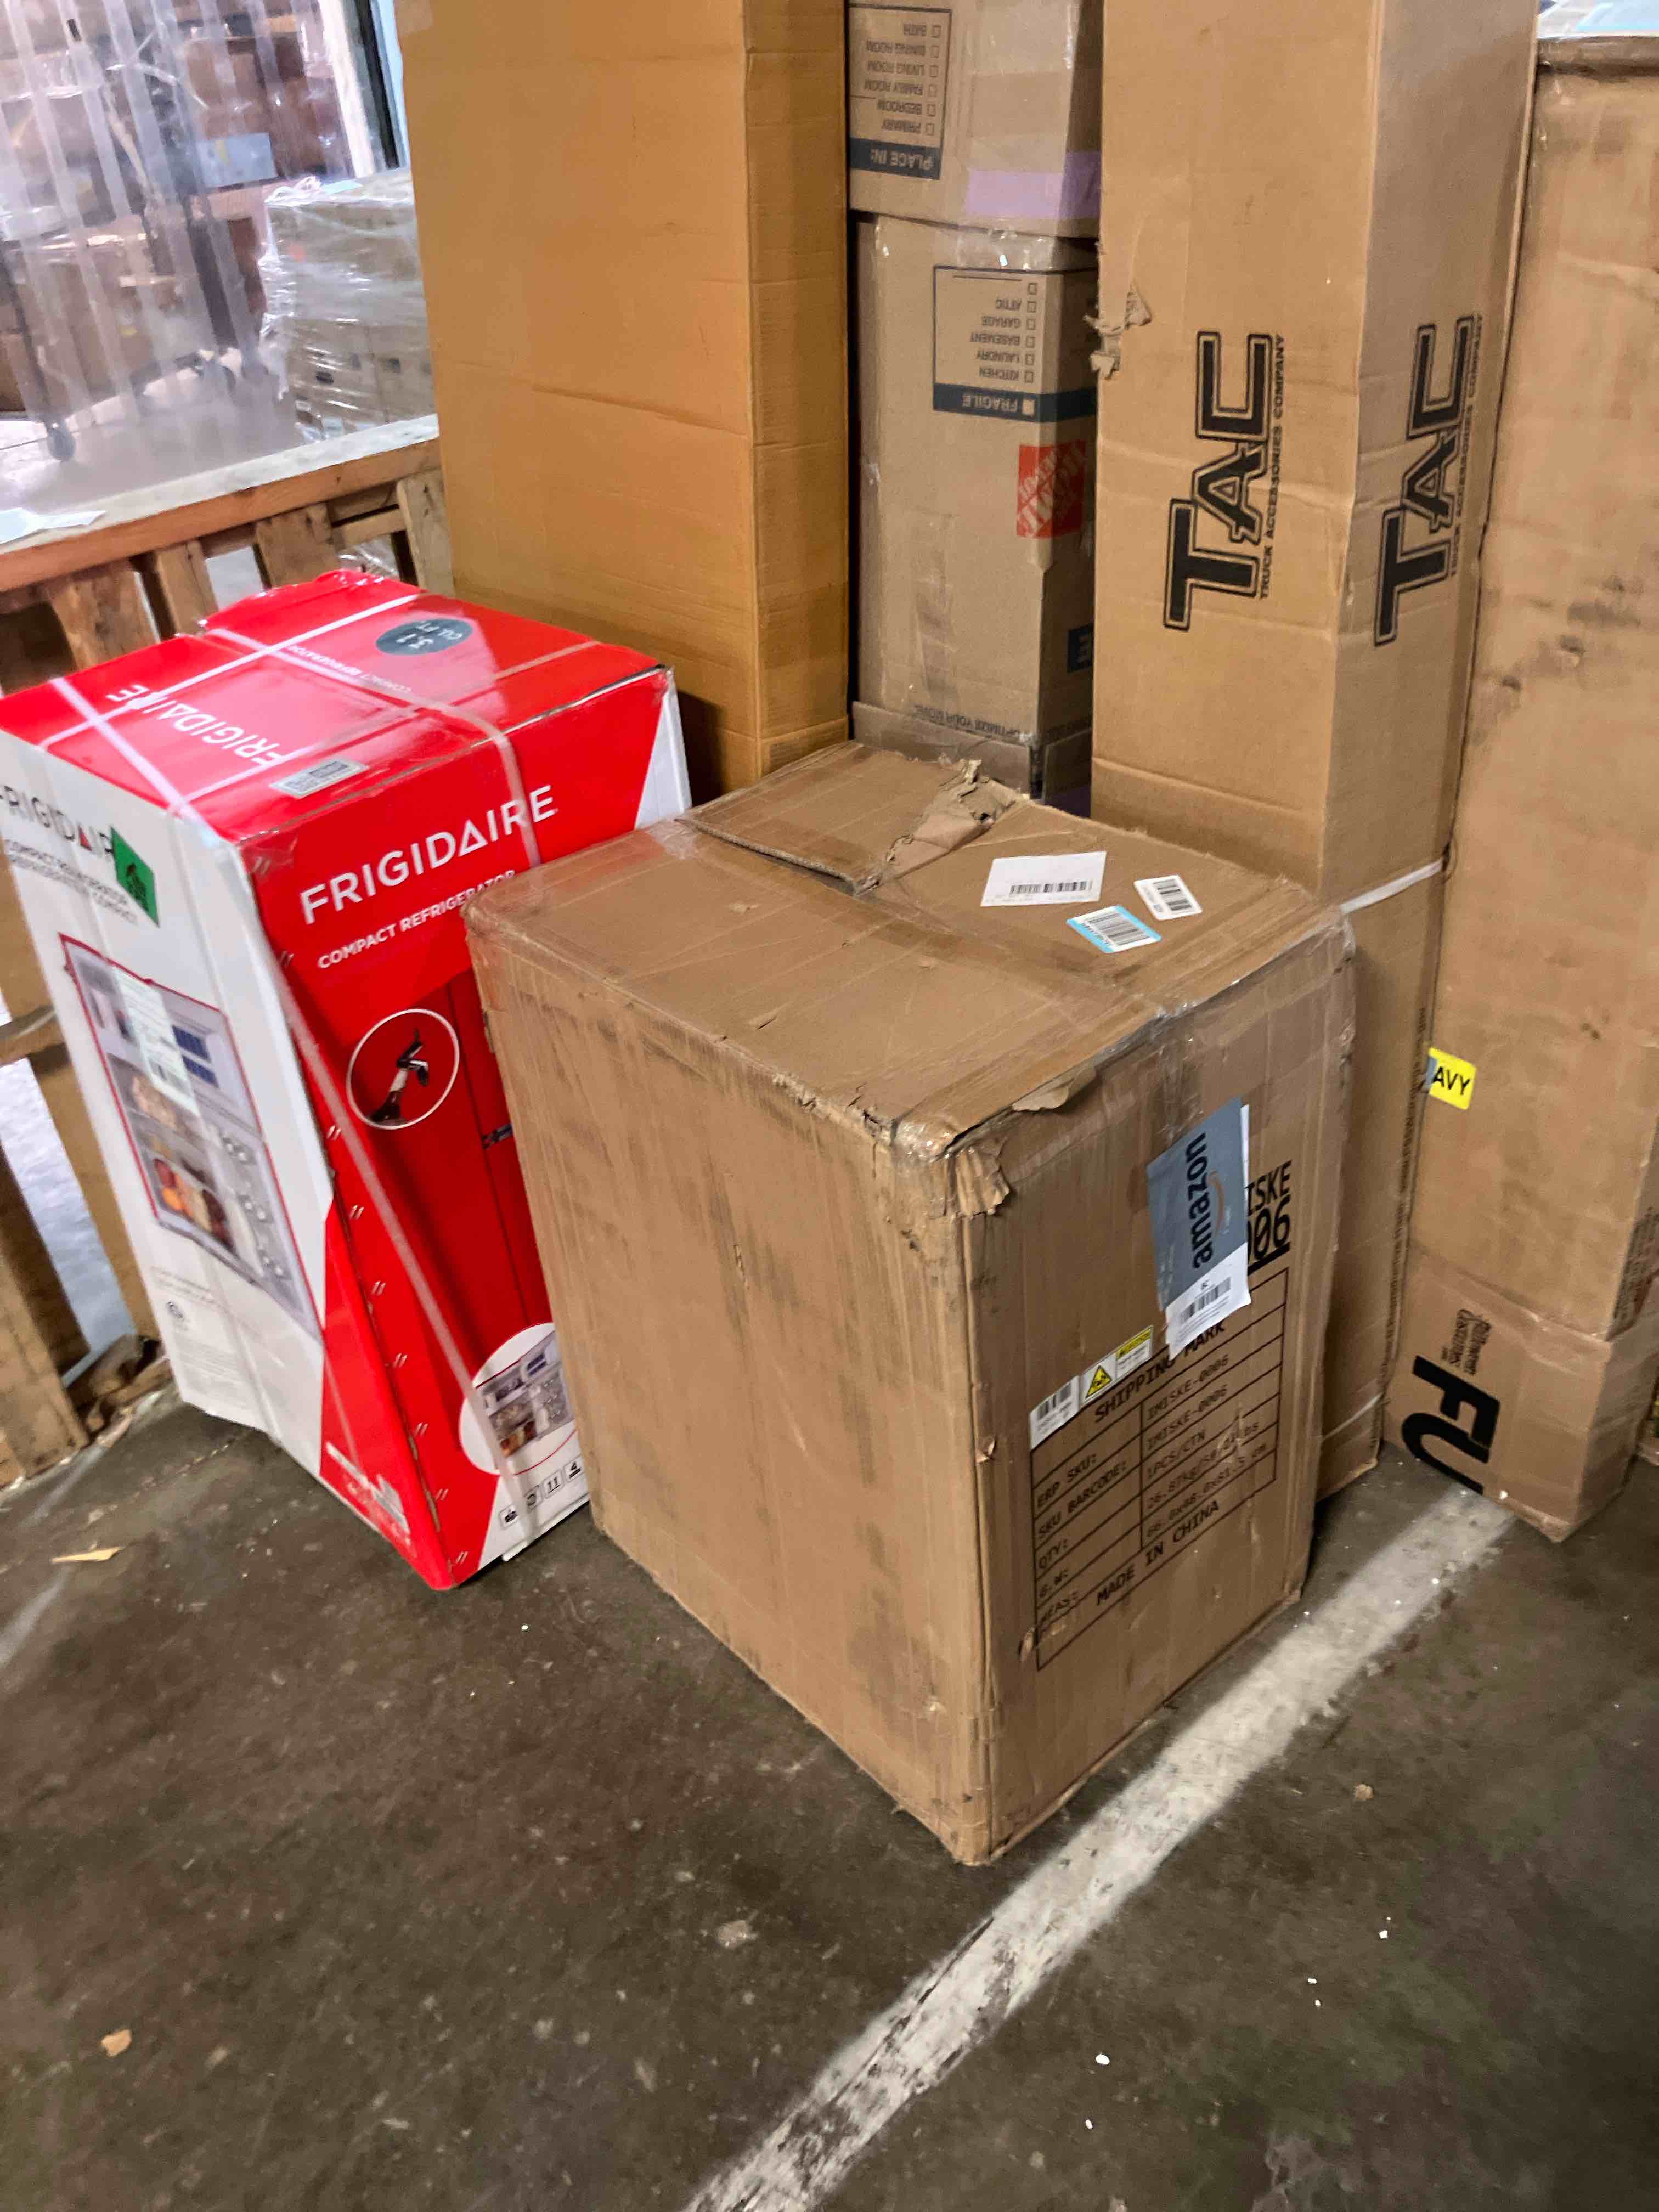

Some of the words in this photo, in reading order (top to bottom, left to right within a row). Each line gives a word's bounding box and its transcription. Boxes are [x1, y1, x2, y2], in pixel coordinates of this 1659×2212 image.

[867, 60, 895, 75] ROOM
[863, 78, 893, 93] ROOM
[877, 99, 922, 115] BEDROOM
[869, 148, 887, 163] IN:
[890, 152, 934, 172] PLACE
[996, 298, 1022, 310] ATTIC
[981, 315, 1021, 329] GARAGE
[969, 332, 1020, 347] BASEMENT
[977, 351, 1020, 364] LAUNDRY
[979, 366, 1020, 381] KITCHEN
[1271, 332, 1285, 419] COMPANY
[961, 393, 1019, 414] FRAGILE
[1163, 330, 1273, 631] TAC
[1266, 425, 1284, 539] ACCESSORIES
[1374, 314, 1475, 647] TAC
[1260, 546, 1273, 600] TRUCK
[299, 785, 558, 925] FRIGIDAIRE
[317, 922, 396, 969] COMPACT
[1431, 1066, 1471, 1096] AVY
[1184, 1132, 1214, 1269] amazon
[1094, 1356, 1176, 1423] SHIPPING
[1037, 1481, 1061, 1508] ERP
[1066, 1454, 1097, 1483] SKU:
[1039, 1513, 1061, 1536] SKU
[1068, 1461, 1126, 1514] BARCODE:
[1039, 1538, 1068, 1570] QTY:
[1097, 1564, 1135, 1606] MADE
[1146, 1541, 1164, 1566] IN
[1173, 1500, 1220, 1543] CHINA
